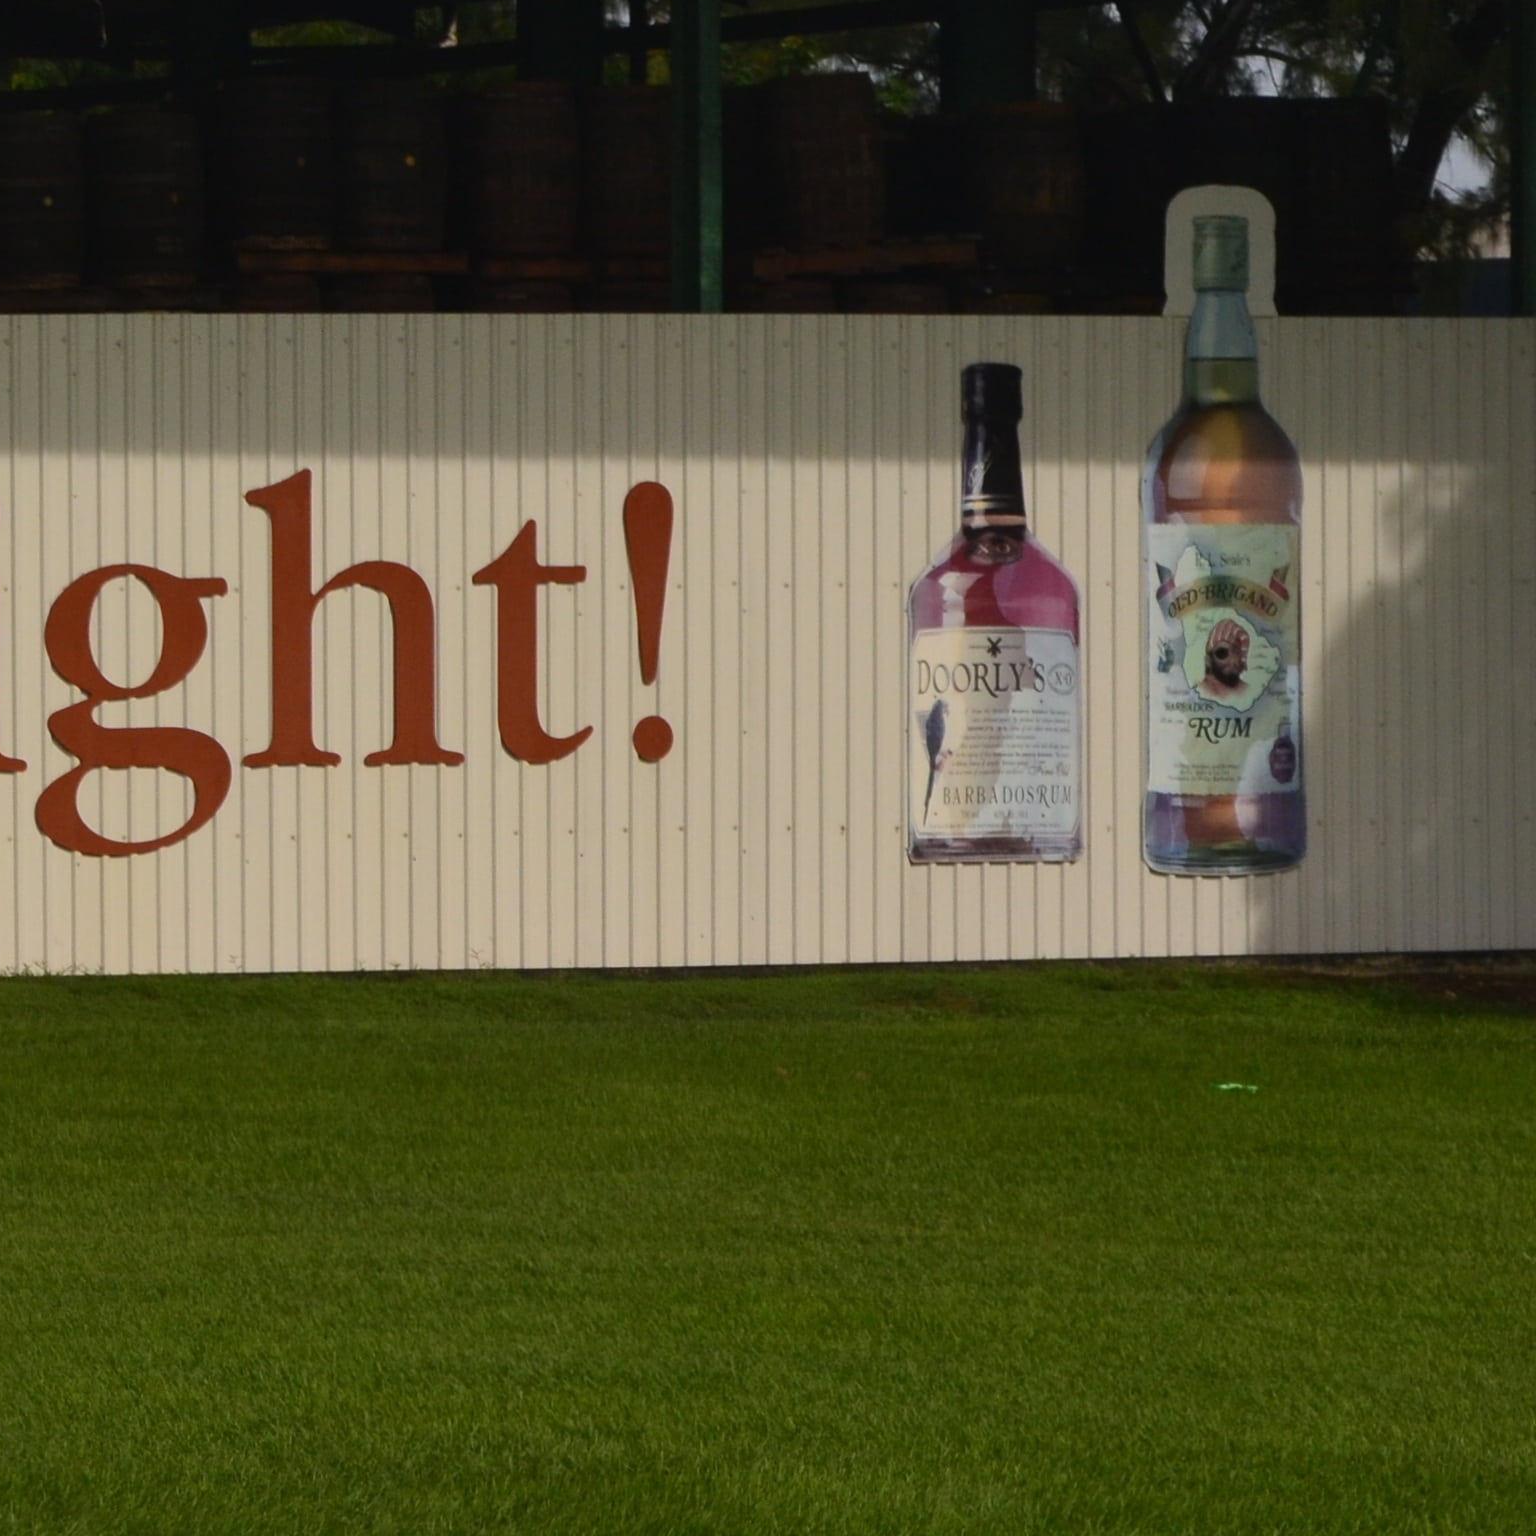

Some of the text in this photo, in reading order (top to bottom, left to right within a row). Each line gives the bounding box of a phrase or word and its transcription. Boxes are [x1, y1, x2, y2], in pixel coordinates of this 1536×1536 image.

[1168, 582, 1278, 618] OLD BRIGAND
[917, 657, 1046, 698] DOORLY'S
[1188, 717, 1253, 744] RUM
[942, 783, 1072, 808] BARBADOS RUM
